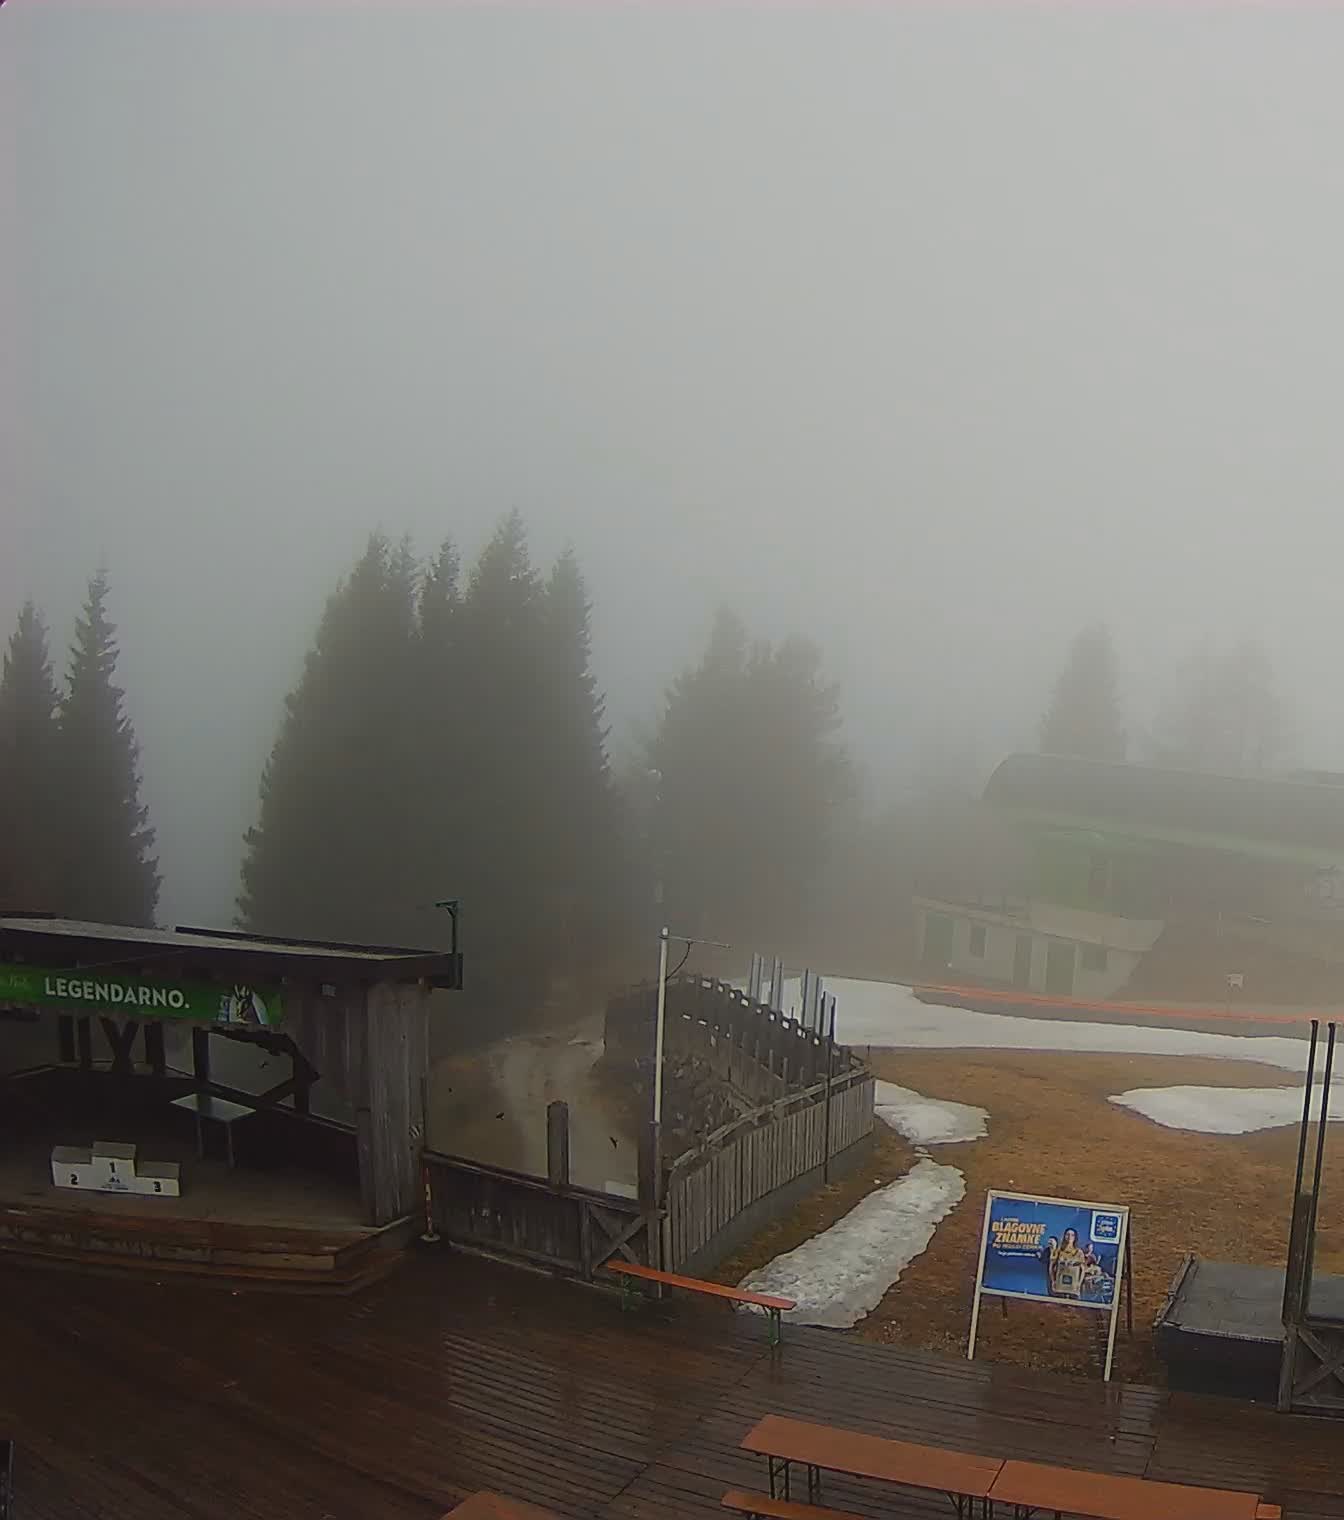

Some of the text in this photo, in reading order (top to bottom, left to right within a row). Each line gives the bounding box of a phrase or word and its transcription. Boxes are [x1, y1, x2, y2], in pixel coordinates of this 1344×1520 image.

[45, 976, 190, 1009] LEGENDARNO.
[109, 1161, 117, 1173] 1
[70, 1173, 79, 1185] 2
[153, 1181, 162, 1193] 3
[992, 1221, 1046, 1234] BLAGOVNE
[994, 1232, 1040, 1245] ZNAMKE
